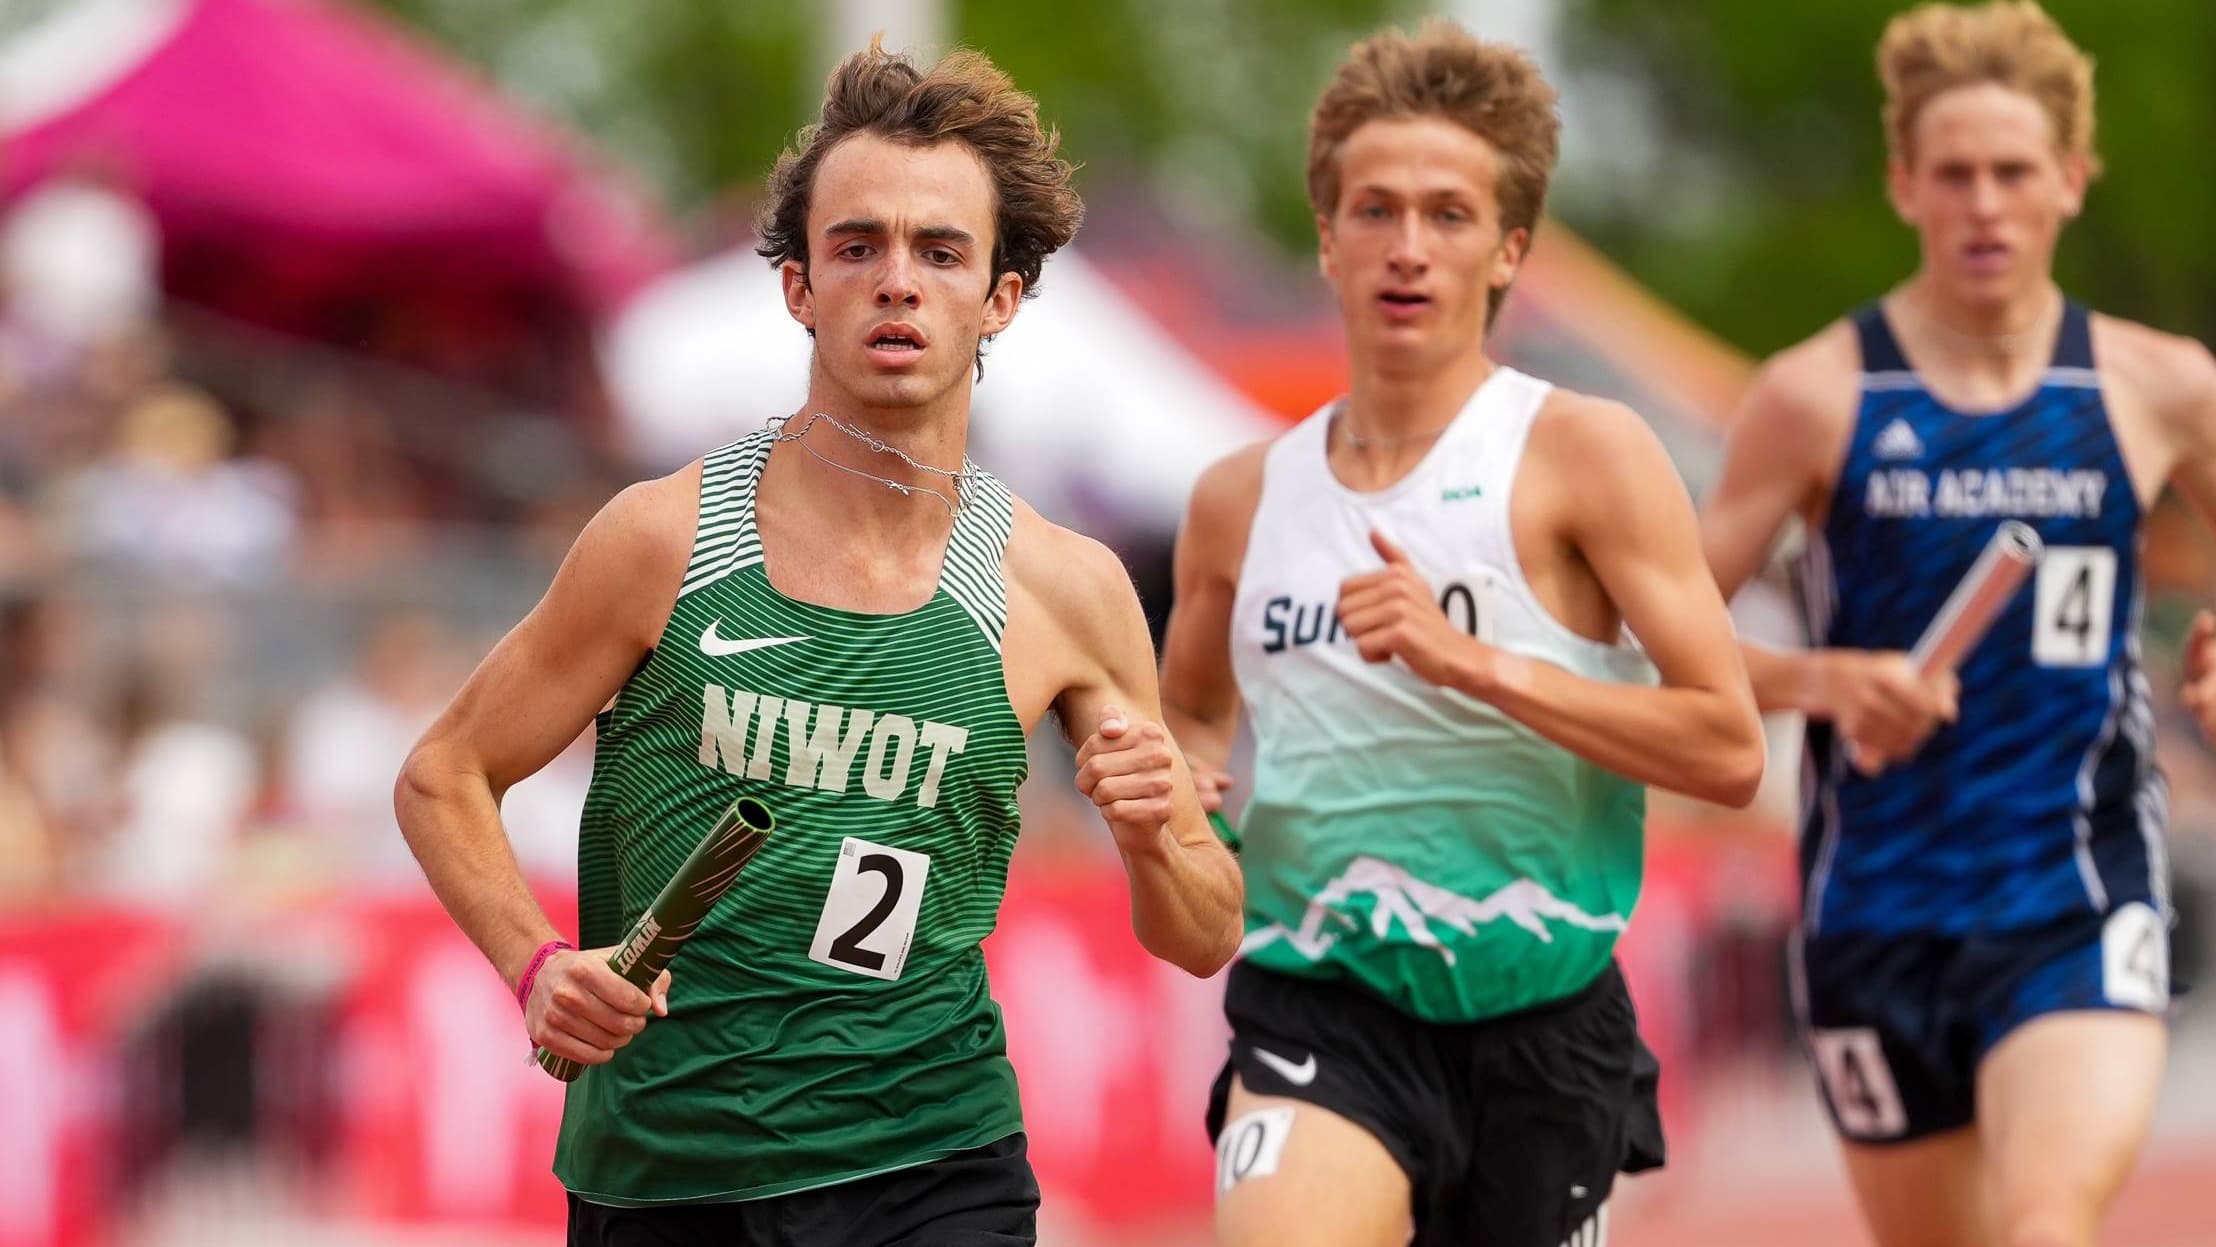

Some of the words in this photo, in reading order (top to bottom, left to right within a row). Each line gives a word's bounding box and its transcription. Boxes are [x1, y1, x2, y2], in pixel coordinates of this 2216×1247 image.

[1864, 467, 1933, 518] AIR
[1934, 467, 2107, 518] ACADEMY
[2055, 563, 2093, 651] 4
[699, 683, 970, 808] NIWOT
[617, 916, 662, 976] NIWOT
[828, 854, 904, 972] 2
